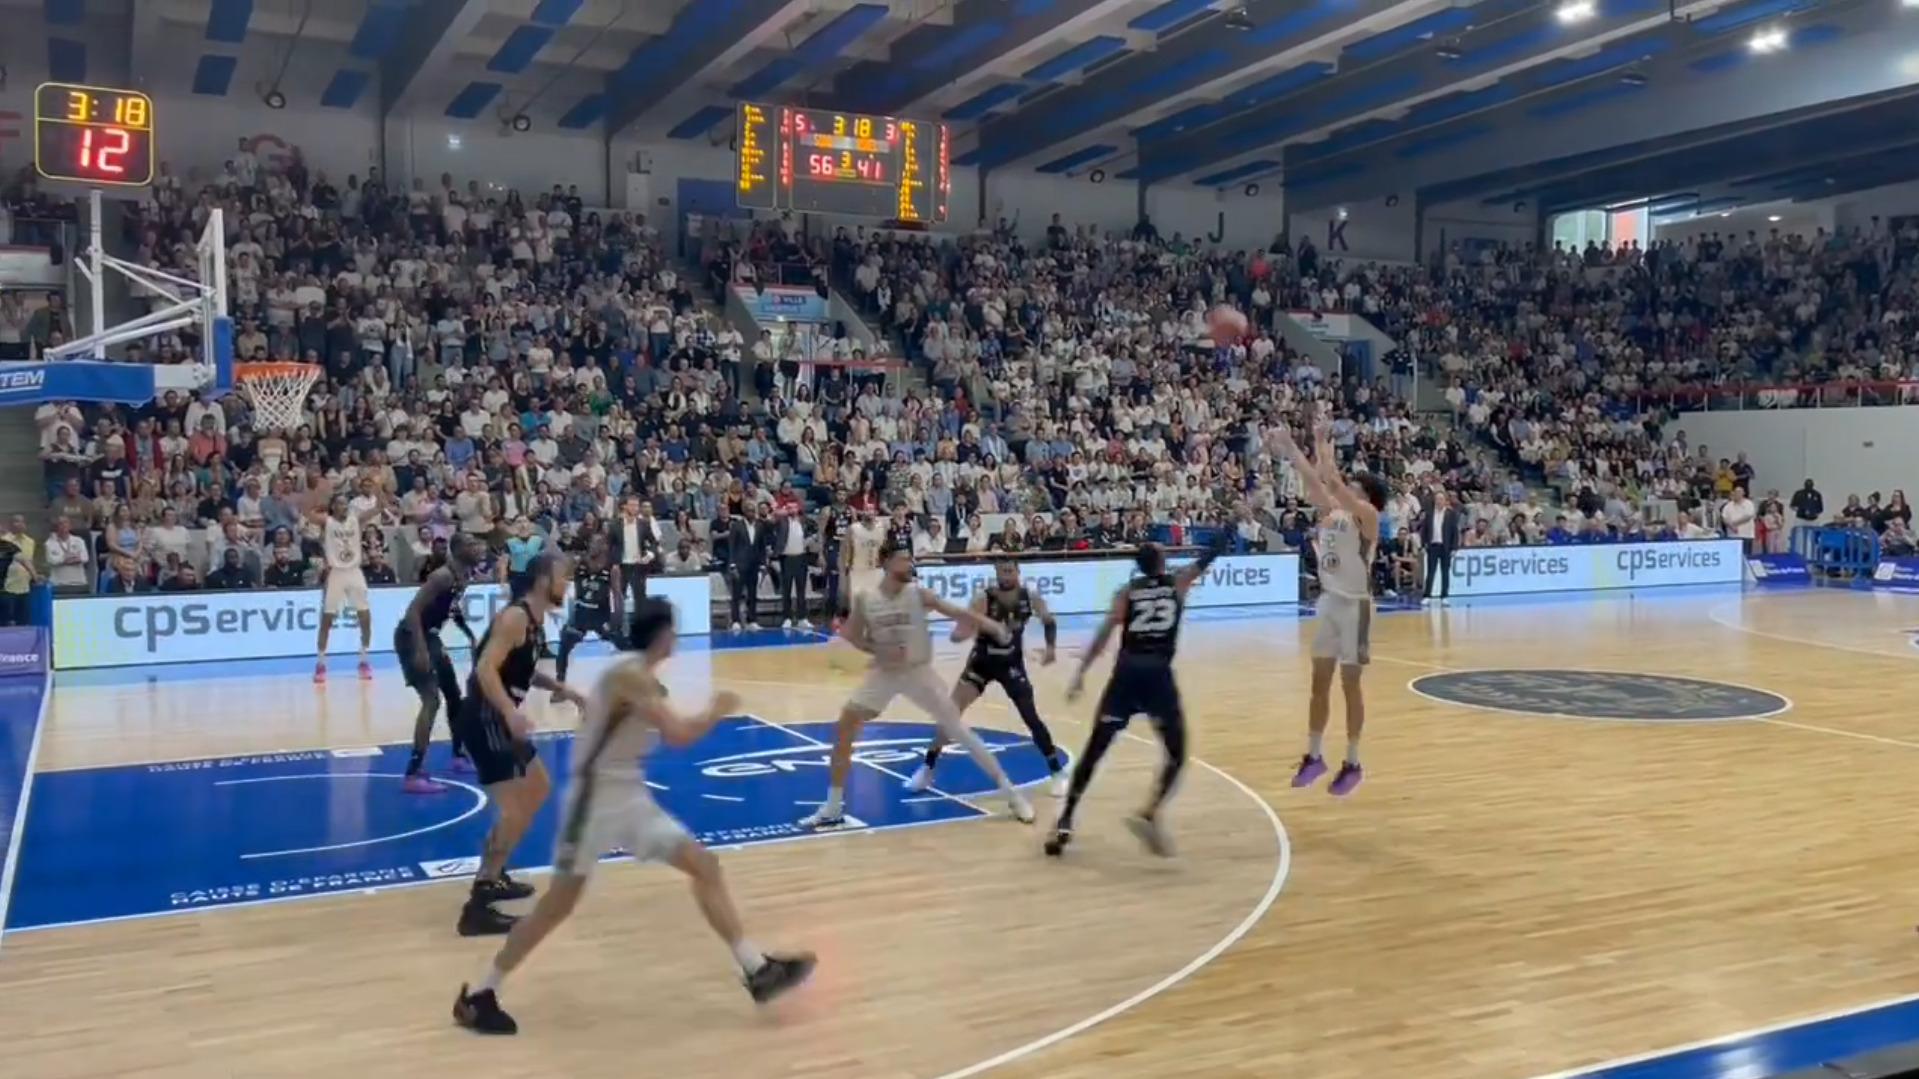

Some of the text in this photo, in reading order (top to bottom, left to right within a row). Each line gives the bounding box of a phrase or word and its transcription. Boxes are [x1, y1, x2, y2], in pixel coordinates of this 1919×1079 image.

[67, 91, 146, 126] 3:18
[79, 128, 130, 173] 12
[809, 153, 834, 176] 56
[857, 159, 881, 180] 41
[1207, 211, 1224, 243] J
[1328, 219, 1350, 251] K
[1451, 552, 1569, 587] cpServices
[1617, 547, 1721, 581] cpServices
[1129, 599, 1176, 632] 23
